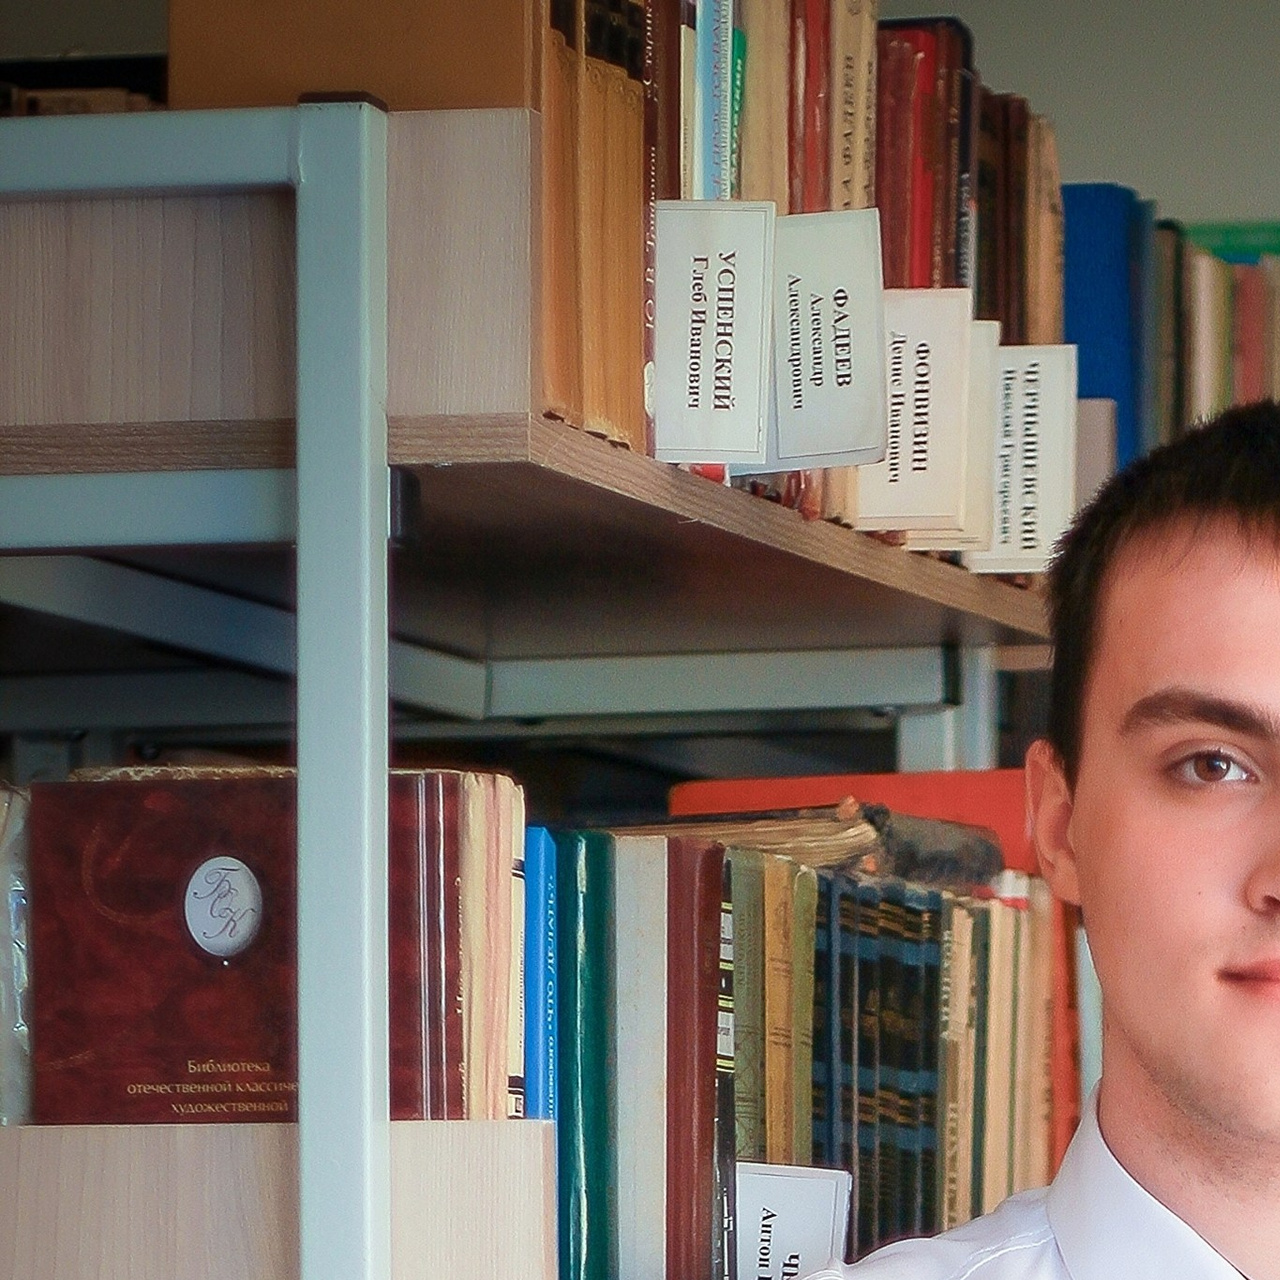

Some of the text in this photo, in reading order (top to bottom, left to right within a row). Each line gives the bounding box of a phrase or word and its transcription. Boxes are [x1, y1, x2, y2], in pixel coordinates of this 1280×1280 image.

[686, 256, 709, 411] Глеб Иванович
[712, 251, 738, 412] УСПЕНСКИЙ
[786, 274, 804, 411] Александрович
[809, 293, 825, 388] Александр
[832, 286, 854, 388] ФАДЕЕВ
[887, 330, 908, 484] Денис Иванович
[911, 341, 932, 473] ФОНВИЗИН
[997, 368, 1018, 545] Николай Григорьевич
[1020, 361, 1042, 551] ЧЕРНЫШЕВСКИЙ
[126, 1080, 232, 1096] отечественной
[170, 1100, 288, 1117] художественной
[186, 1059, 271, 1075] Библиотека
[758, 1207, 778, 1269] Антон
